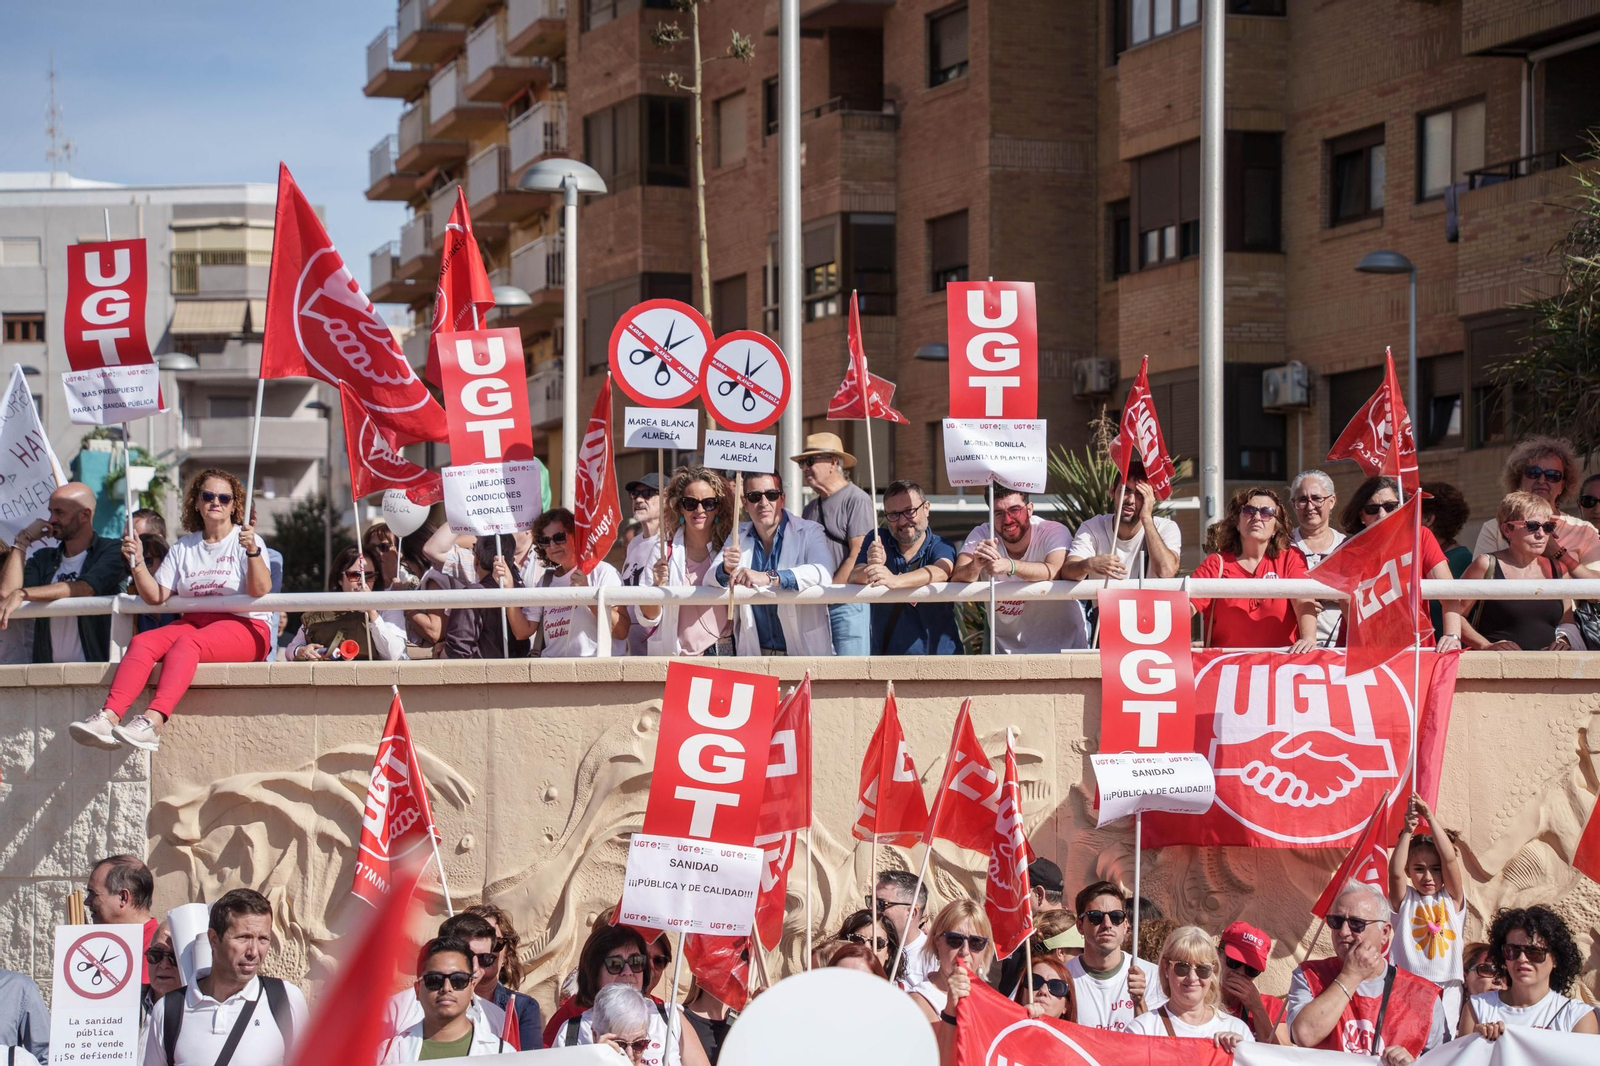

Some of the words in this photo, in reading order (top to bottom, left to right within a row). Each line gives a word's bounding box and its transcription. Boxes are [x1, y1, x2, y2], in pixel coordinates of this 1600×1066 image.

[81, 248, 131, 366] UGT
[628, 324, 646, 340] MAREA
[653, 345, 672, 362] BLANCA
[966, 290, 1020, 417] UGT
[736, 374, 754, 388] BLANCA
[98, 386, 144, 396] PRESUPUESTO
[455, 337, 515, 458] UGT
[72, 406, 92, 414] PARA
[628, 418, 658, 426] MAREA
[660, 419, 695, 428] BLANCA
[642, 430, 680, 440] ALMERÍA
[706, 438, 736, 448] MAREA
[739, 441, 772, 451] BLANCA
[720, 452, 758, 463] ALMERÍA
[470, 478, 516, 490] ¡¡¡MEJORES
[466, 491, 522, 502] CONDICIONES
[466, 505, 523, 517] LABORALES!!!
[189, 580, 227, 591] Sanidad
[1118, 600, 1177, 748] UGT
[1214, 664, 1378, 743] UGT
[674, 676, 754, 838] UGT
[1132, 768, 1175, 777] SANIDAD
[1104, 789, 1148, 801] ¡¡¡PÚBLICA
[1169, 785, 1211, 794] CALIDAD!!!
[670, 858, 718, 873] SANIDAD
[628, 878, 678, 890] ¡¡¡PÚBLICA
[688, 884, 701, 892] DE
[703, 886, 753, 898] CALIDAD!!!
[1243, 932, 1258, 942] UGT
[85, 1017, 123, 1025] sanidad
[76, 1028, 114, 1038] pública
[80, 1051, 133, 1060] defiende!!
